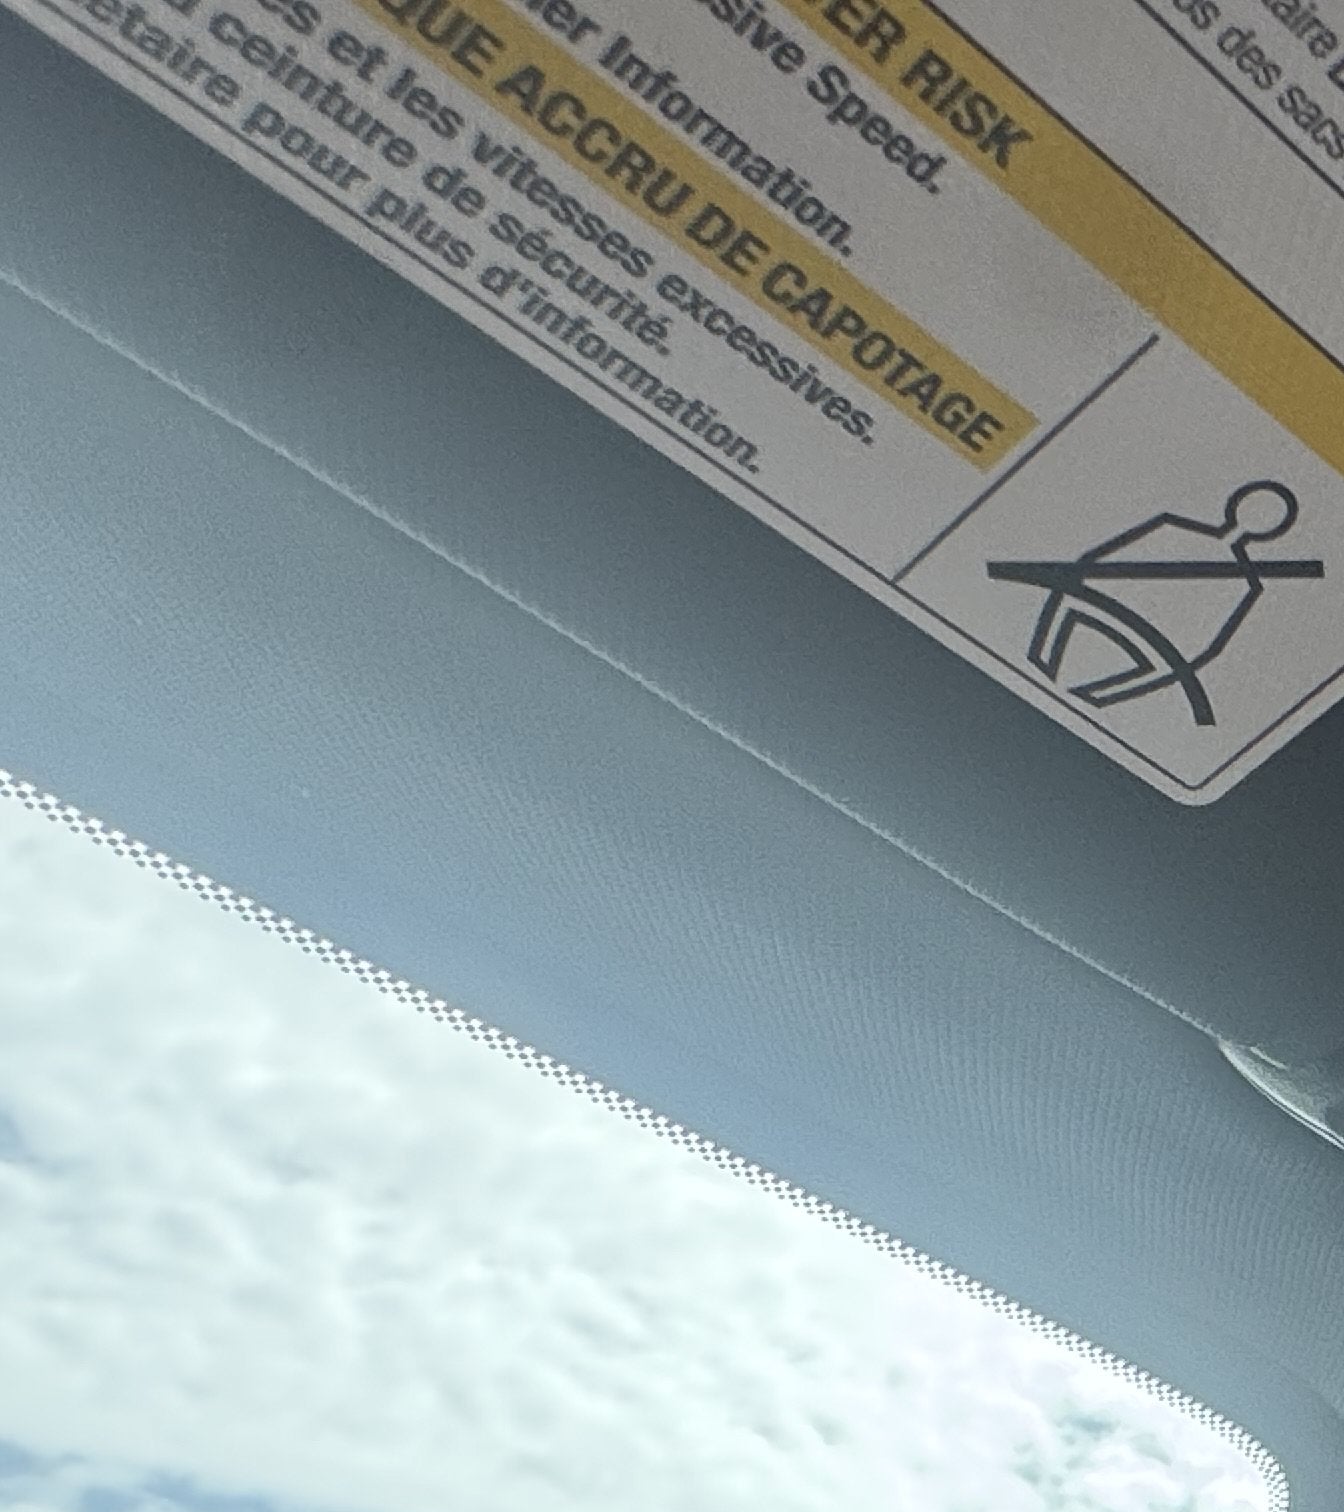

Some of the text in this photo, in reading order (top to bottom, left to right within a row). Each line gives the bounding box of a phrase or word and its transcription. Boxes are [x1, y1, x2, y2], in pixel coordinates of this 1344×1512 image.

[524, 0, 853, 258] er Information.
[806, 63, 948, 195] Speed.
[900, 48, 1035, 171] RISK
[1216, 23, 1284, 91] des
[1261, 0, 1339, 60] aire
[208, 11, 670, 357] ceinture de sécurité.
[241, 101, 371, 192] pour
[365, 186, 475, 270] plus
[479, 260, 760, 474] d'information.
[326, 29, 390, 85] et
[385, 67, 466, 141] les
[471, 130, 656, 279] vitesses
[656, 271, 876, 446] excessives.
[494, 62, 698, 219] ACCRU
[685, 202, 771, 278] DE
[761, 260, 1008, 454] CAPOTAGE
